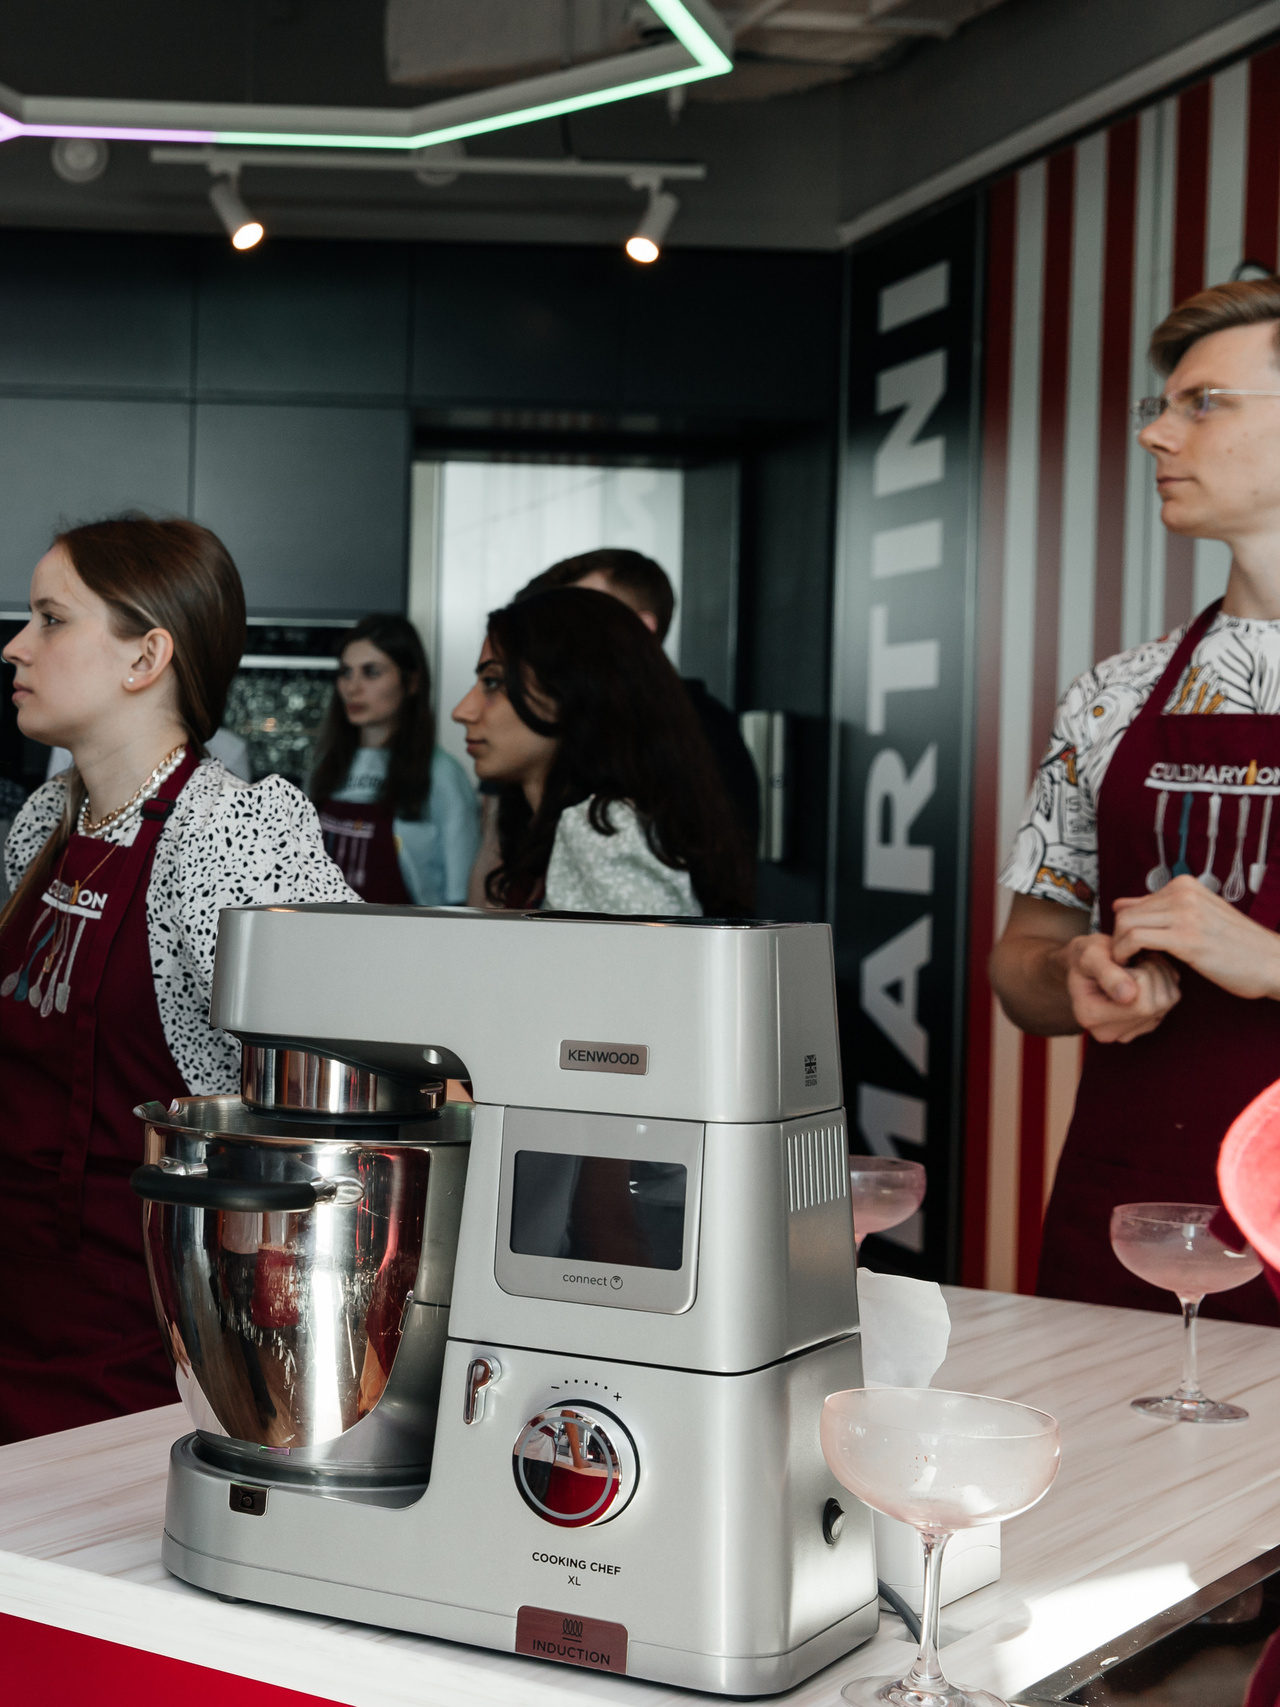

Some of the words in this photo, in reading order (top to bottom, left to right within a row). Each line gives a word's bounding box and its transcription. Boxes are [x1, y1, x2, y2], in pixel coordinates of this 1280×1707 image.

[568, 1049, 639, 1065] KENWOOD
[562, 1274, 608, 1287] connect
[531, 1552, 587, 1570] COOKING
[590, 1562, 622, 1575] CHEF
[567, 1575, 581, 1586] XL
[532, 1639, 610, 1665] INDUCTION
